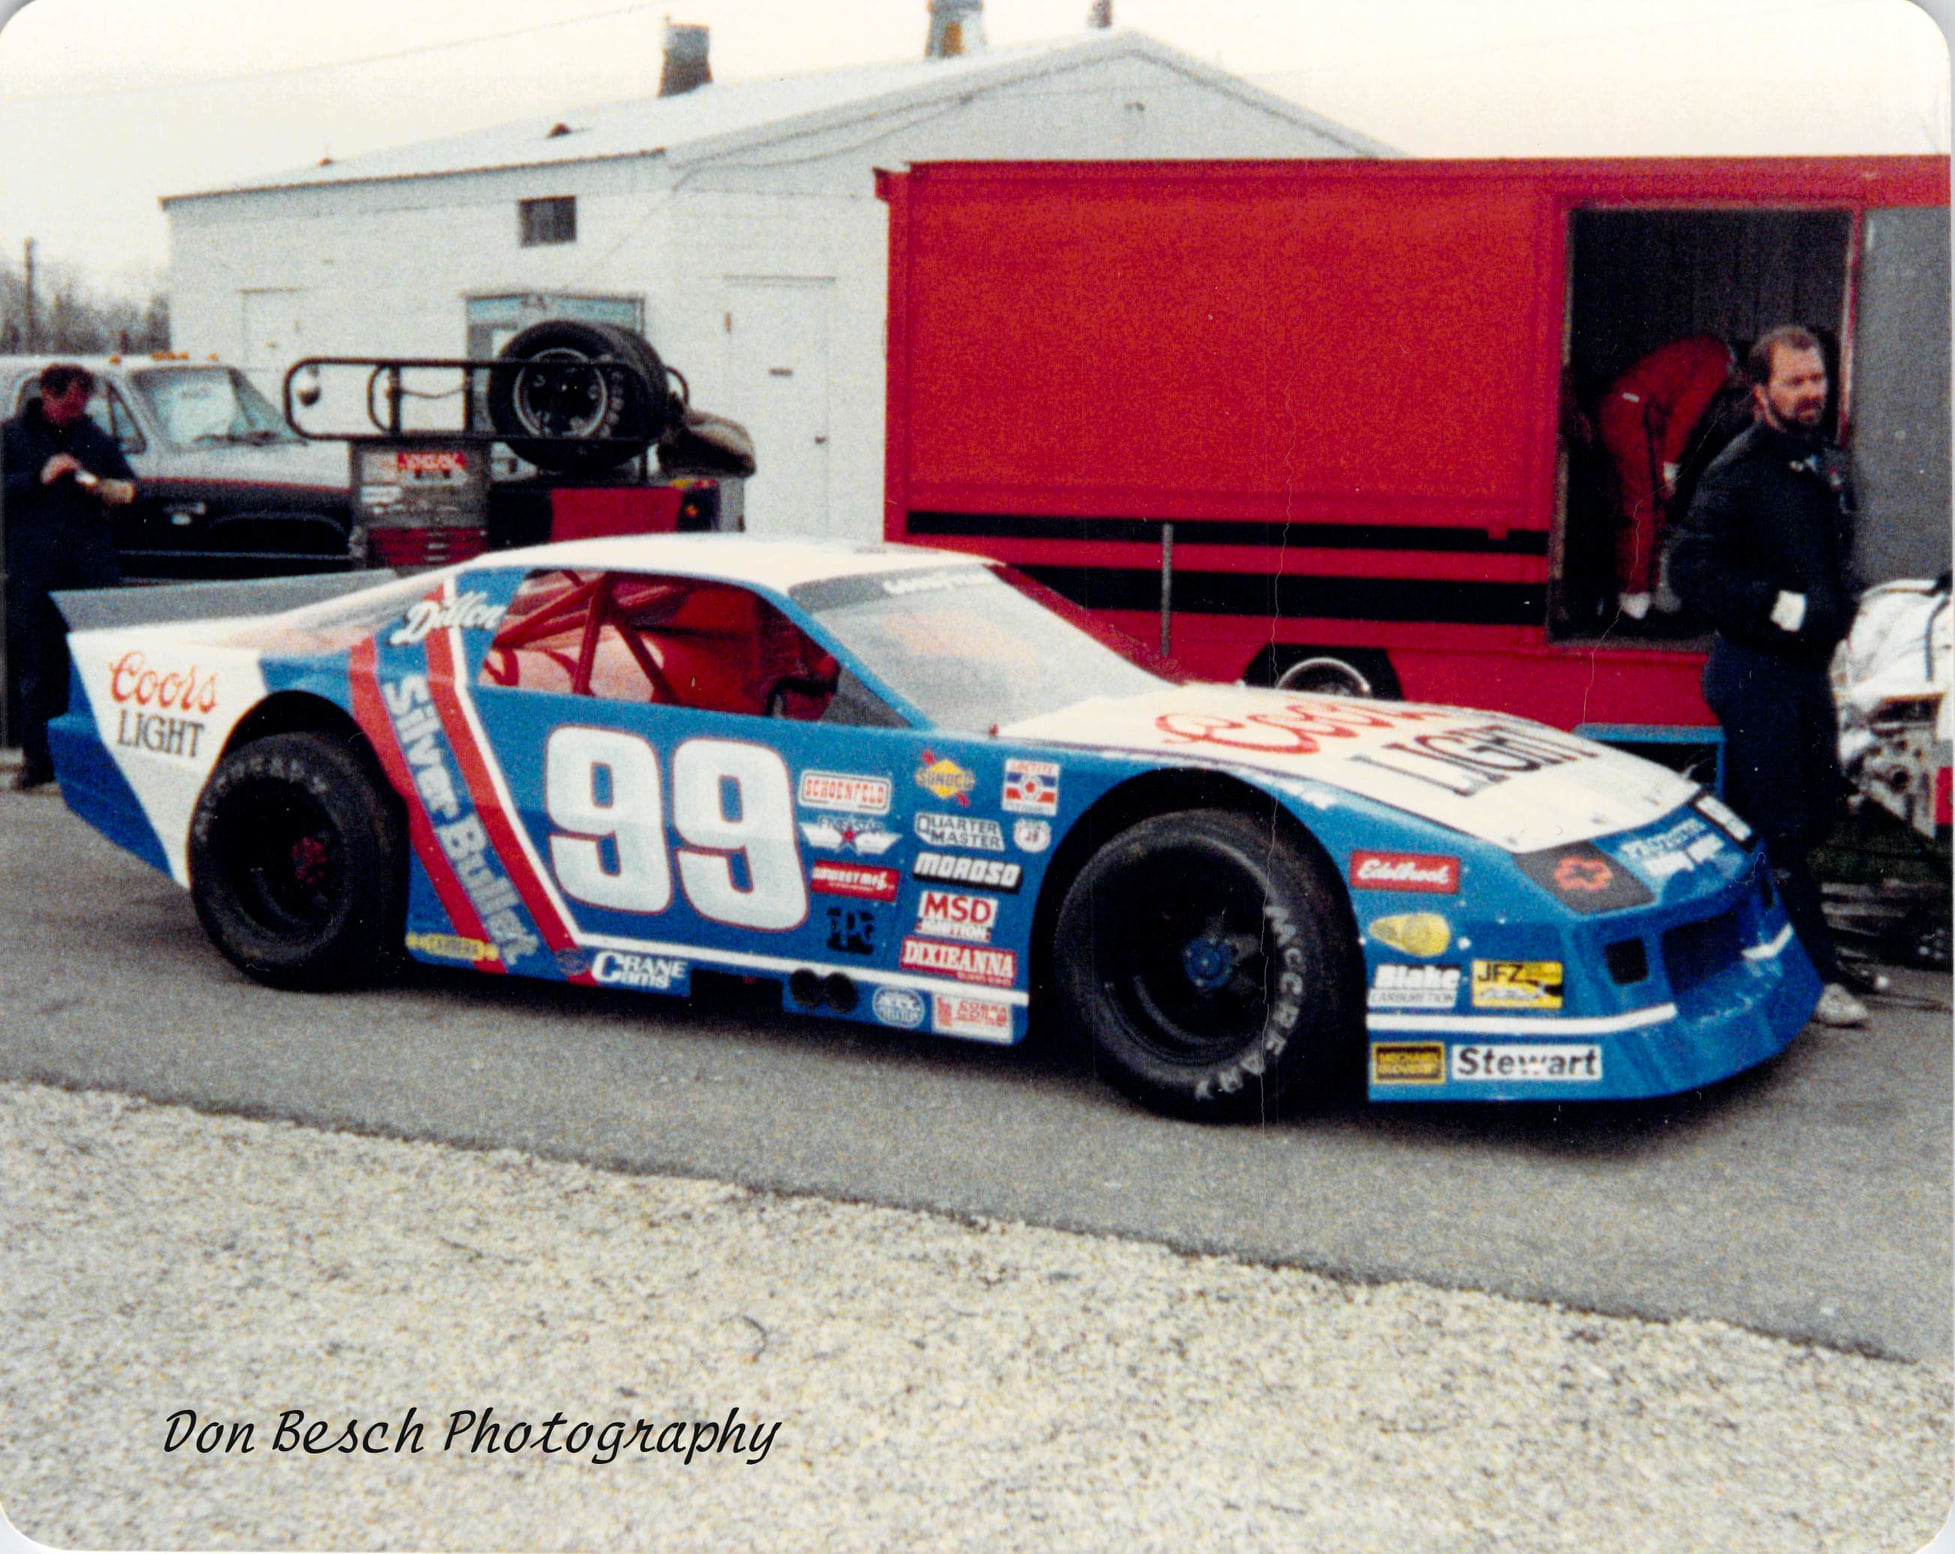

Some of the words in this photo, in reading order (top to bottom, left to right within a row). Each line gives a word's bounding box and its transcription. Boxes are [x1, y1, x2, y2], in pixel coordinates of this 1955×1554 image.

[107, 649, 218, 715] Coors
[116, 708, 206, 760] LIGHT
[1154, 699, 1450, 756] Coor
[805, 777, 886, 805] SCHOENFELD
[914, 766, 976, 793] SUNOCO
[545, 723, 810, 933] 99
[916, 813, 999, 836] QUARTER
[930, 829, 1001, 849] MASTER
[913, 851, 1022, 889] MOROSO
[923, 891, 992, 924] MSD
[1477, 962, 1525, 984] JFZ
[1458, 1047, 1597, 1077] Stewart
